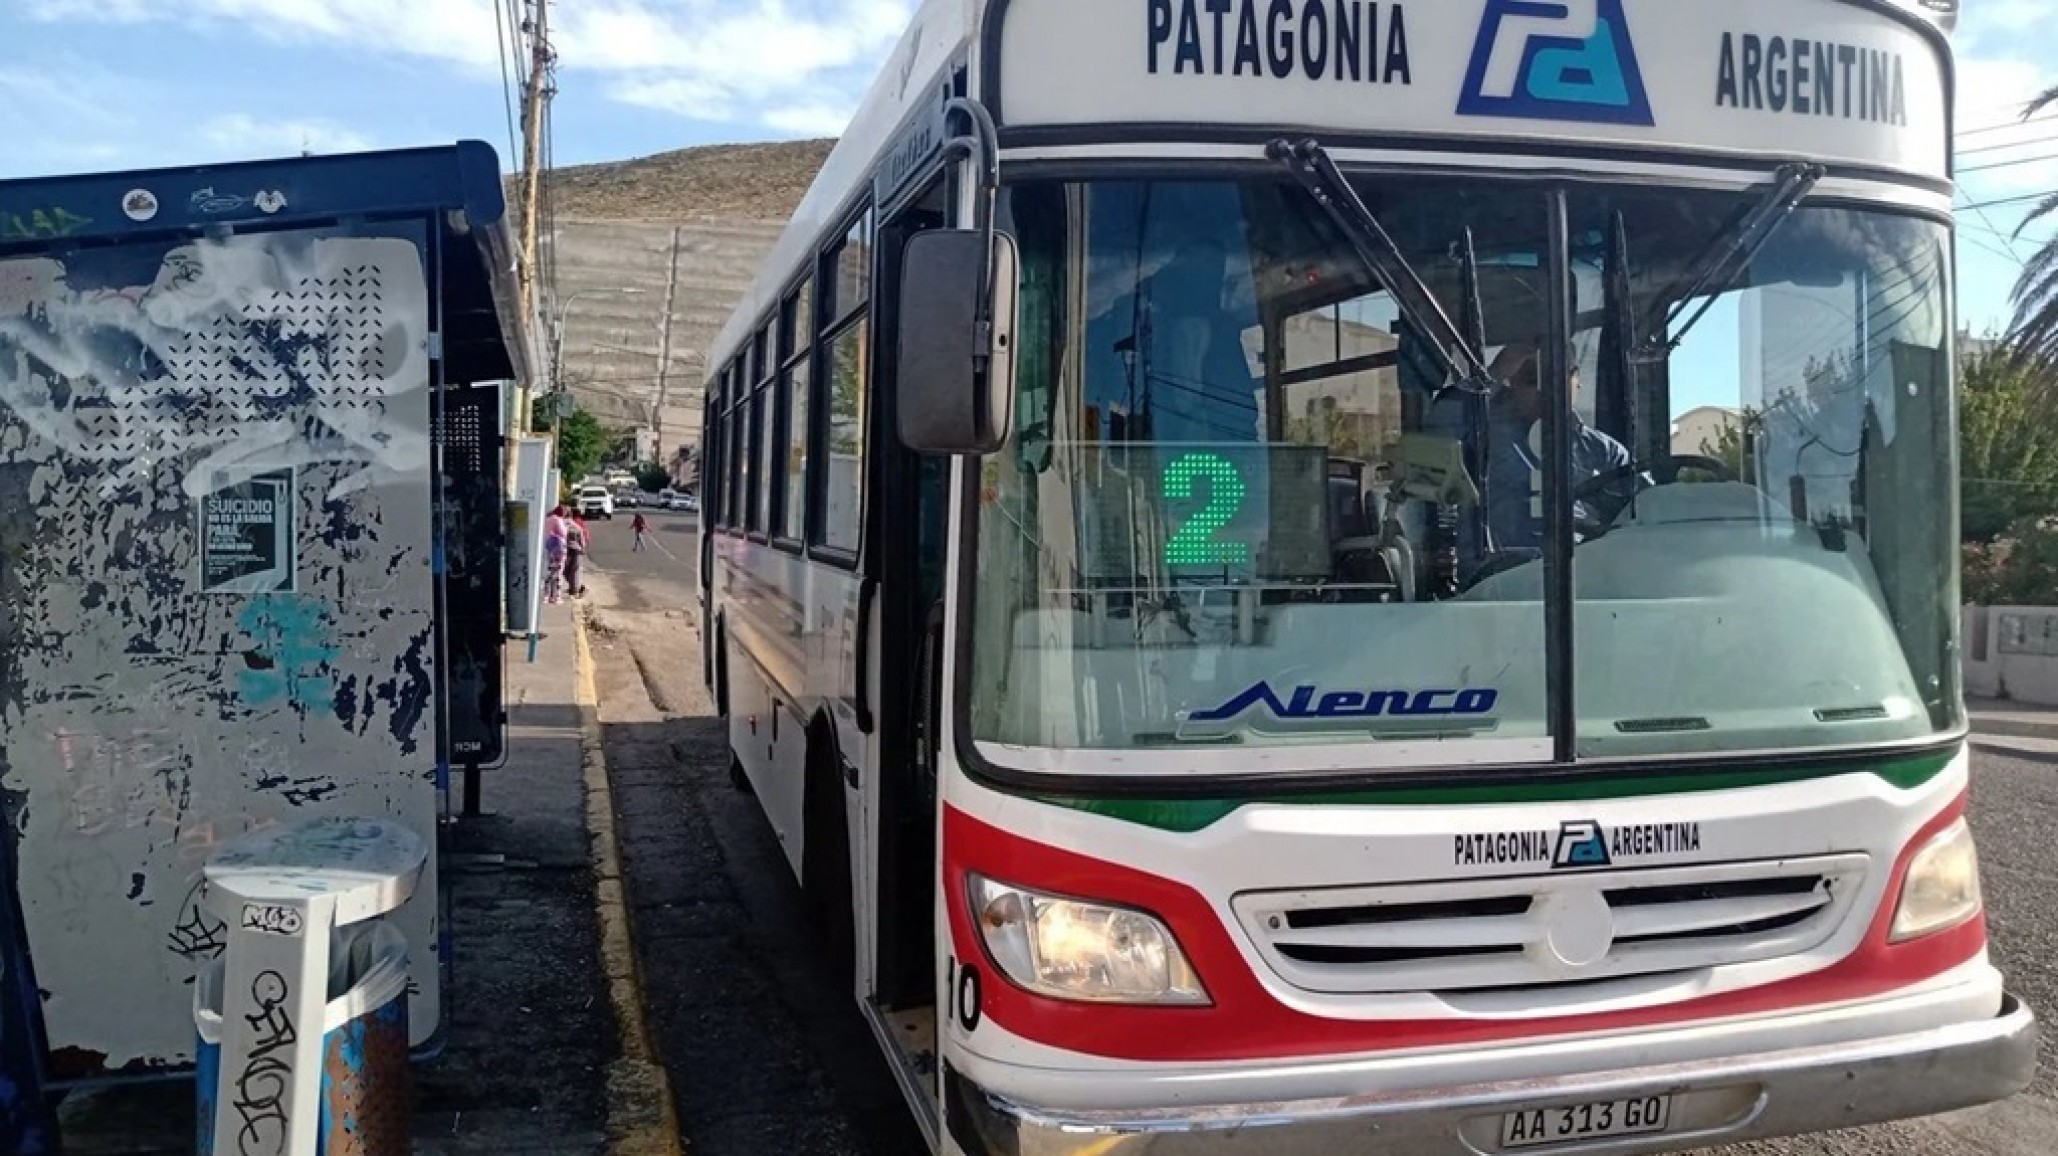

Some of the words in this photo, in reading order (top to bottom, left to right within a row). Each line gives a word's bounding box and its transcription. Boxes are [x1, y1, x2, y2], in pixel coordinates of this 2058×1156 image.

[1147, 0, 1411, 85] PATAGONIA
[1715, 31, 1906, 127] ARGENTINA
[208, 499, 273, 514] SUICIDIO
[1164, 453, 1246, 564] 2
[1188, 680, 1498, 720] Alenco
[1454, 831, 1550, 866] PATAGONIA
[1611, 821, 1701, 856] ARGENTINA
[1510, 1110, 1546, 1141] AA
[1557, 1101, 1615, 1135] 313
